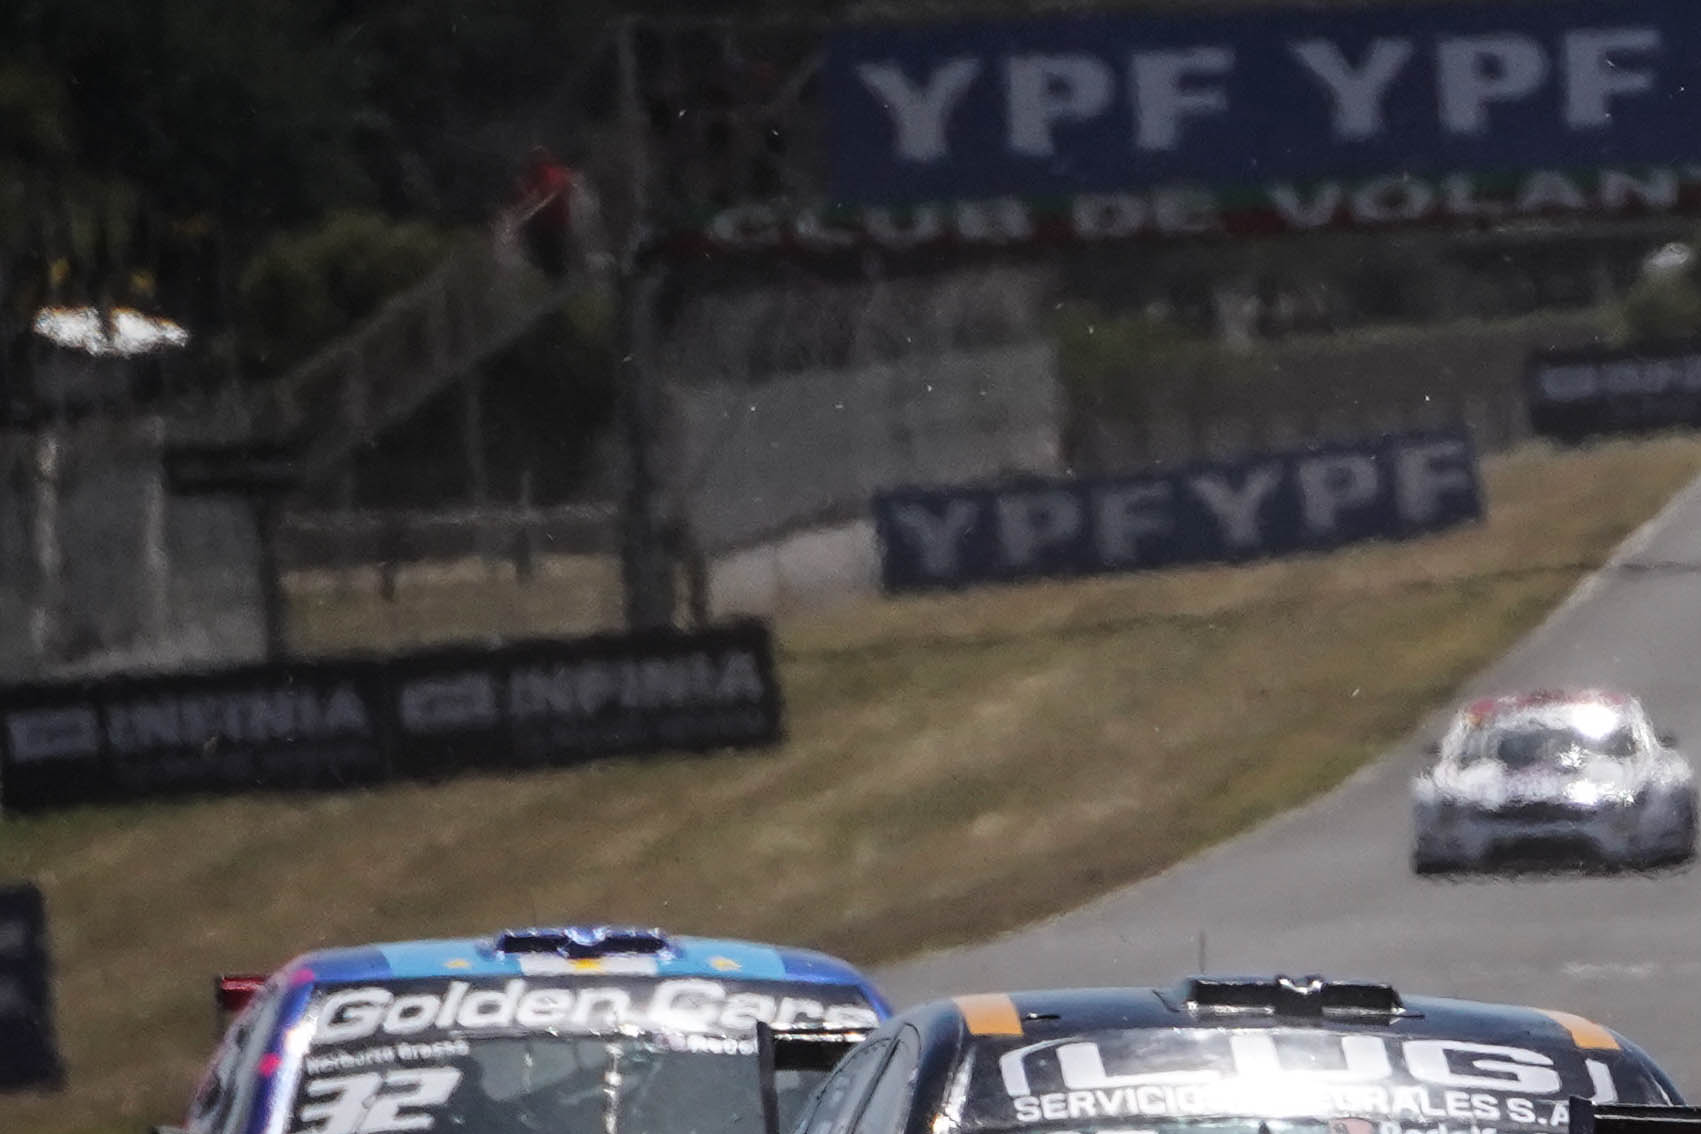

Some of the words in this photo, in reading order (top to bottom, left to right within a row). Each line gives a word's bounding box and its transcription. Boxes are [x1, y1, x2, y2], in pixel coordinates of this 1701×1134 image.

[855, 47, 1238, 162] YPF
[1287, 26, 1663, 141] YPF
[893, 479, 1172, 578] YPF
[1189, 439, 1465, 549] YPF
[315, 978, 622, 1045] Golden
[645, 978, 880, 1034] Cars
[1014, 1083, 1226, 1122] SERVICIO
